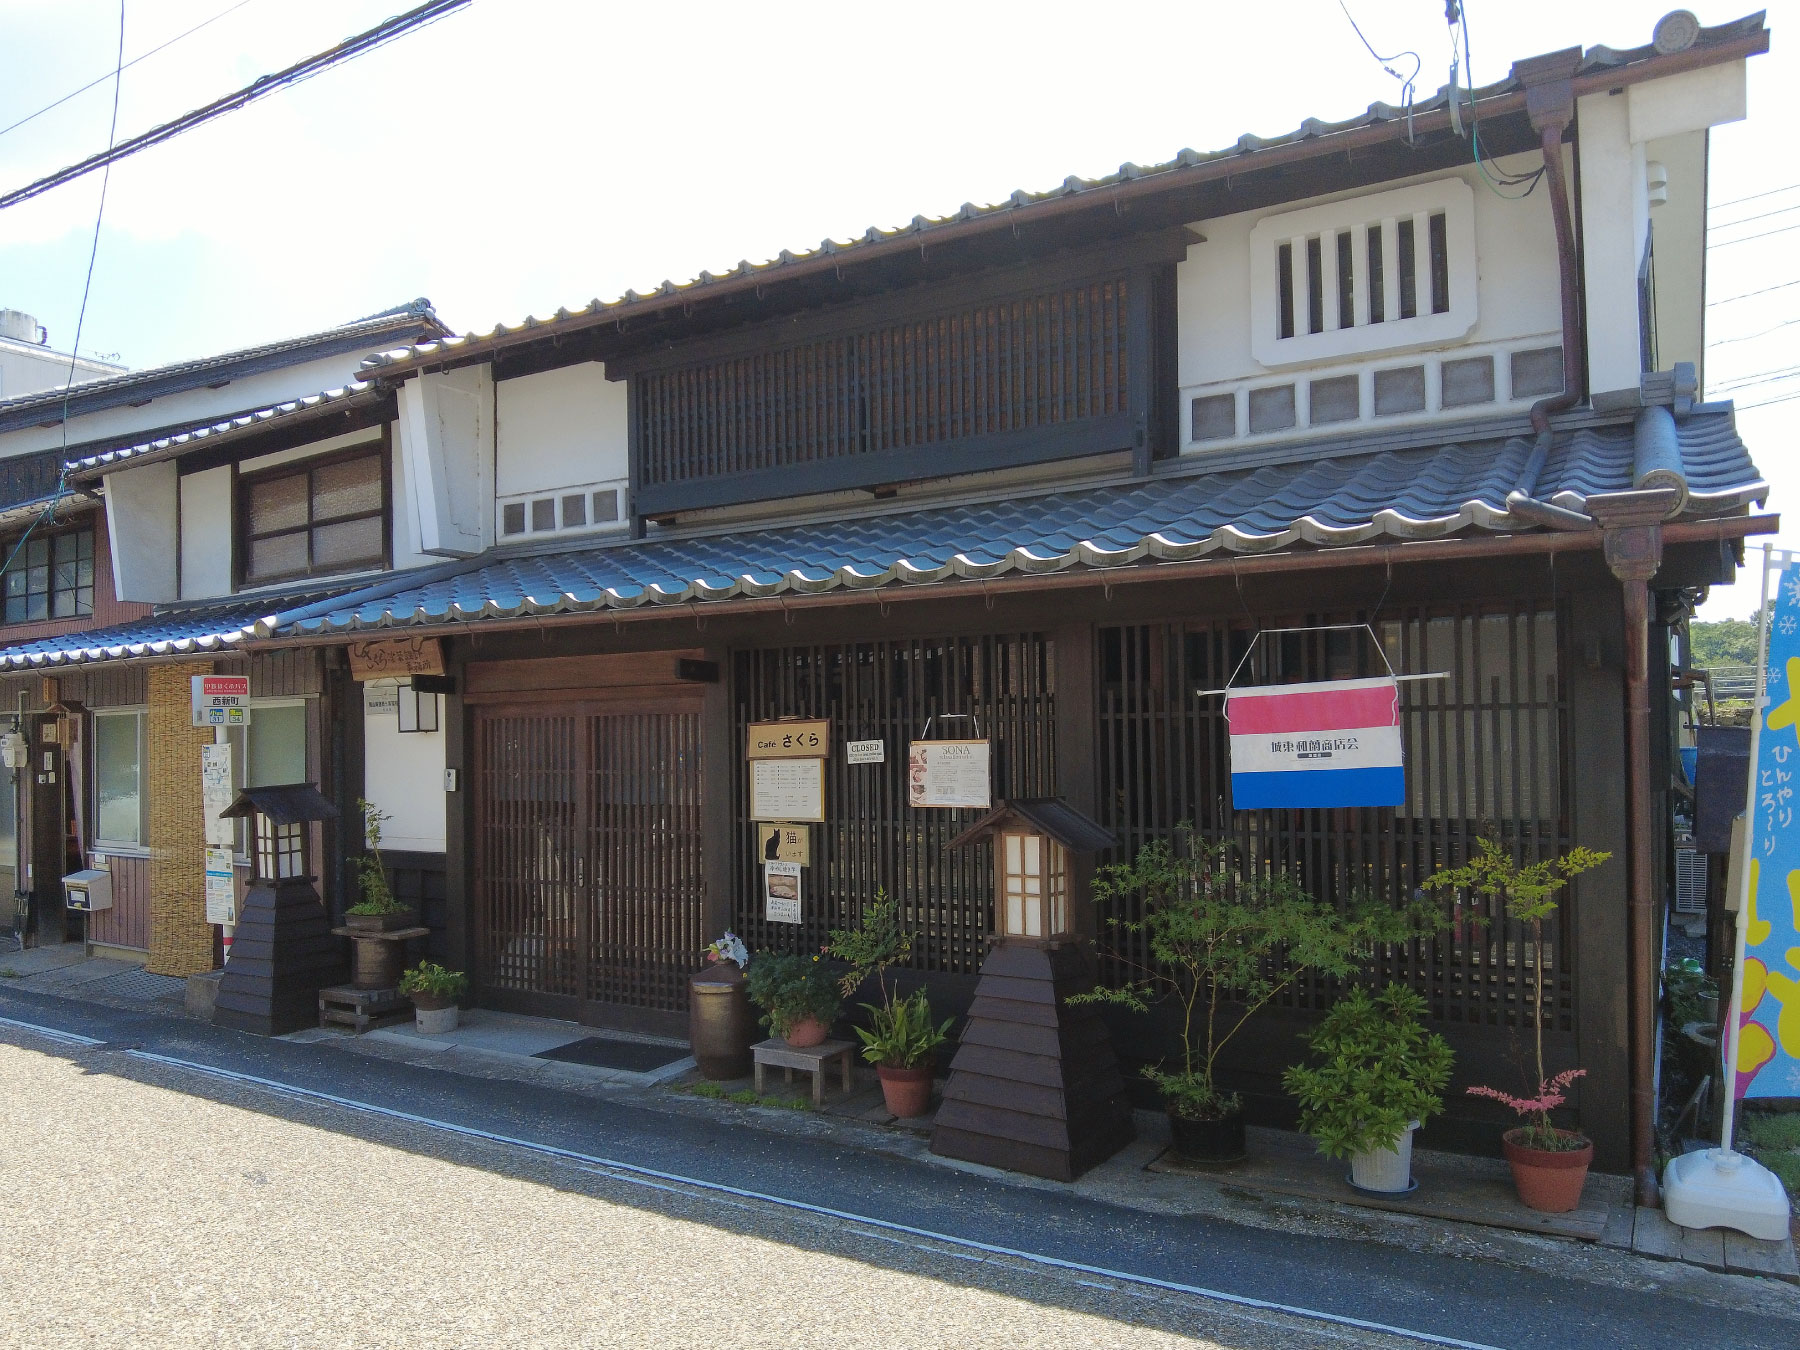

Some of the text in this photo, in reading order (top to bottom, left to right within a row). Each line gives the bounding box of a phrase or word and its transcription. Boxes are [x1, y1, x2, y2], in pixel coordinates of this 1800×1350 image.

[212, 696, 239, 706] 西新町
[757, 732, 819, 749] Café さくら
[851, 743, 879, 753] CLOSED
[941, 745, 971, 755] SONA
[1772, 745, 1793, 828] ひんやり
